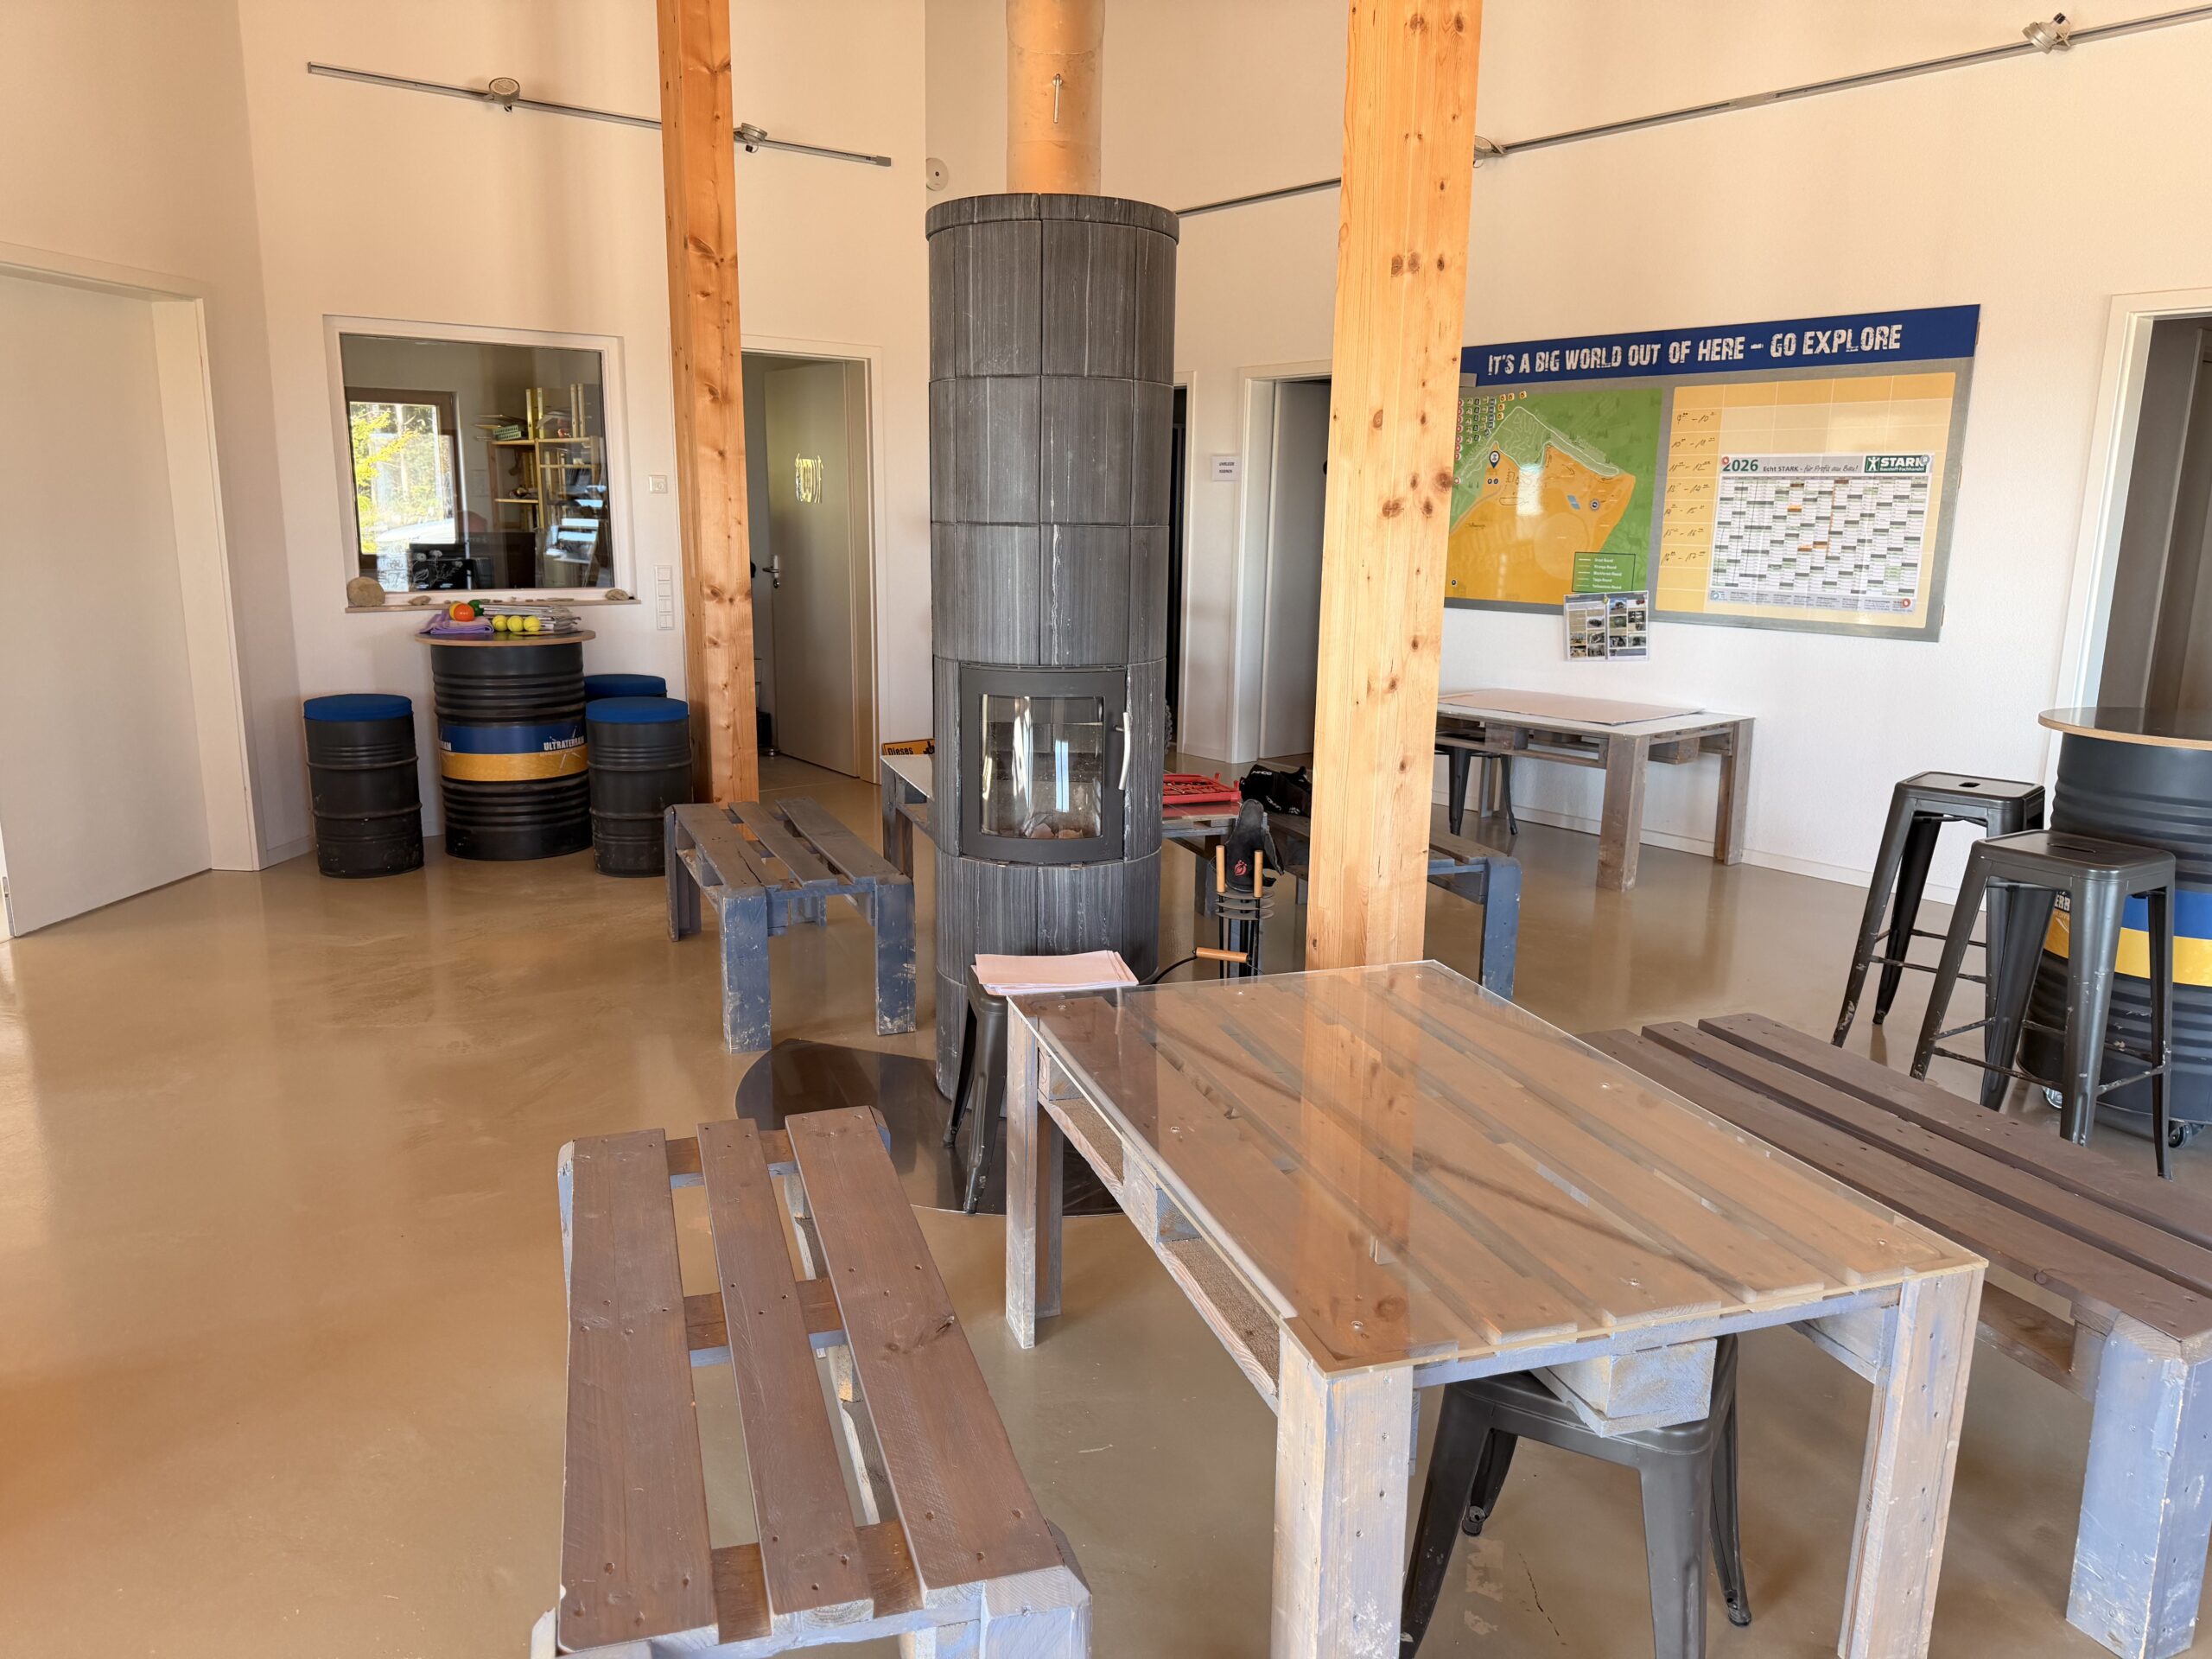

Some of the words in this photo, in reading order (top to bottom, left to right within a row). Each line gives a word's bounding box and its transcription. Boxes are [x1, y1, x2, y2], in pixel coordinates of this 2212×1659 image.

[1488, 353, 1516, 376] IT'S
[1519, 353, 1530, 373] A
[1535, 349, 1560, 372] BIG
[1566, 346, 1622, 370] WORLD
[1628, 343, 1661, 366] OUT
[1669, 340, 1691, 364] OF
[1697, 336, 1745, 361] HERE
[1770, 333, 1796, 358] GO
[1802, 324, 1903, 355] EXPLORE
[1722, 458, 1758, 472] 2026
[1880, 457, 1925, 467] STARK
[887, 747, 913, 755] Dieses
